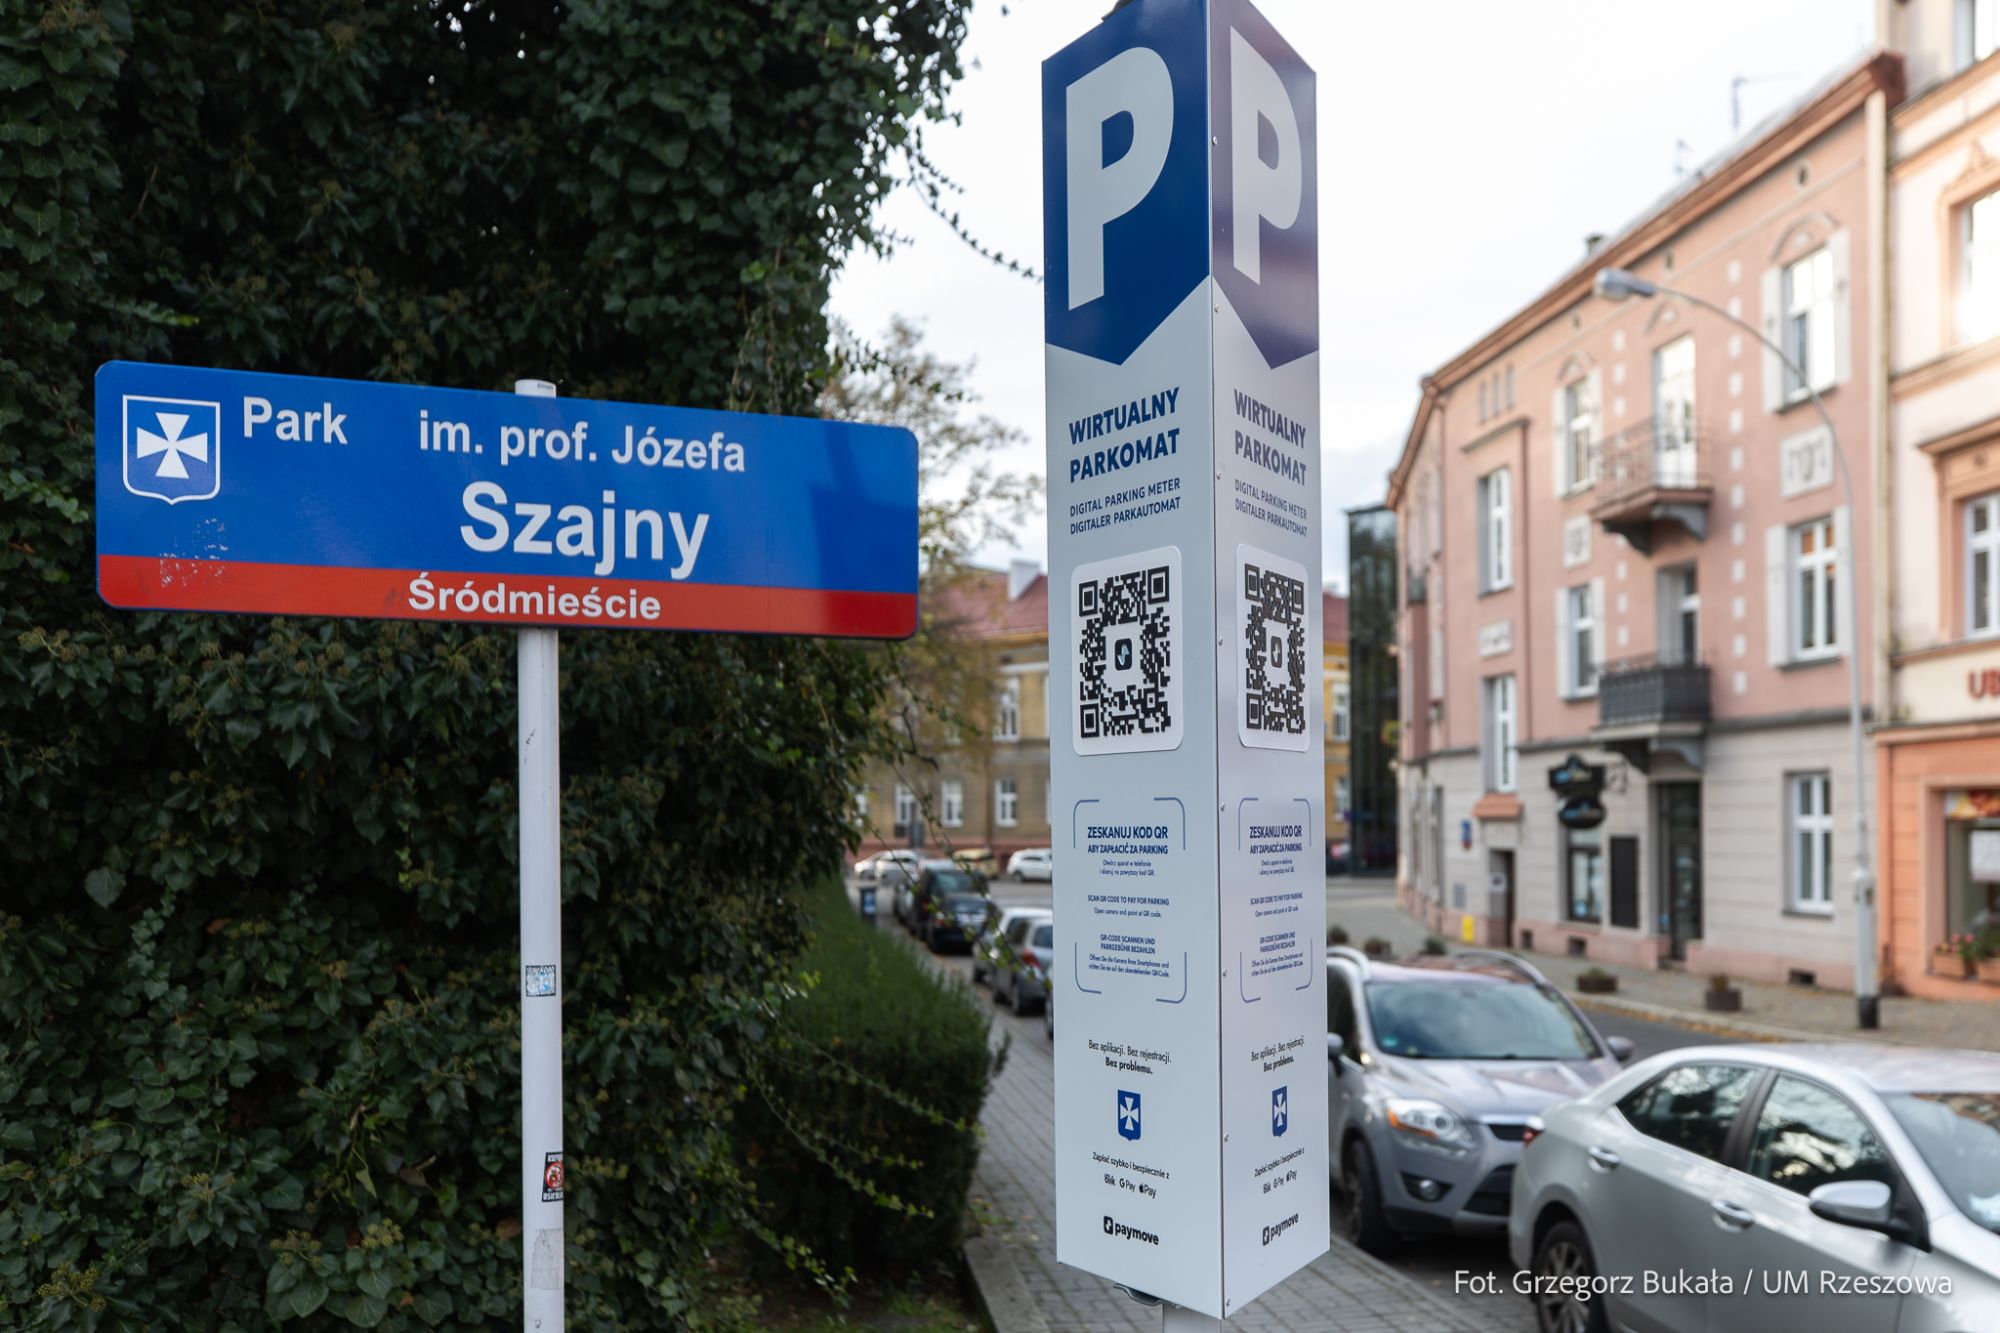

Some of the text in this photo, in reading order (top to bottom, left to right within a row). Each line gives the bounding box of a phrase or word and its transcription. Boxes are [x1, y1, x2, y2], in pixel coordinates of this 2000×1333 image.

[1230, 25, 1302, 286] P
[1066, 46, 1174, 311] P
[244, 396, 745, 472] Park im. prof. Józefa
[1069, 386, 1180, 445] WIRTUALNY
[1234, 388, 1306, 448] WIRTUALNY
[1070, 427, 1180, 483] PARKOMAT
[1235, 430, 1306, 486] PARKOMAT
[1070, 478, 1180, 517] DIGITAL PARKING METER
[1070, 496, 1181, 535] DIGITALER PARKAUTOMAT
[1235, 479, 1307, 520] DIGITAL PARKING METER
[1235, 498, 1307, 536] DIGITALER PARKAUTOMAT
[460, 481, 710, 580] Szajny
[408, 571, 661, 620] Śródmieście
[1087, 826, 1168, 839] ZESKANUJ KOD QR
[1088, 842, 1168, 854] ABY ZAPŁACIĆ ZA PARKING
[1250, 825, 1302, 838] ZESKANUJ KOD QR
[1089, 1040, 1172, 1064] Bez aplikacji. Bez rejestracji.
[1105, 1057, 1153, 1074] Bez problemu.
[1110, 1158, 1129, 1169] szybko
[1133, 1162, 1165, 1178] bezpiecznie
[1115, 1222, 1159, 1245] paymove
[1271, 1213, 1299, 1241] paymove
